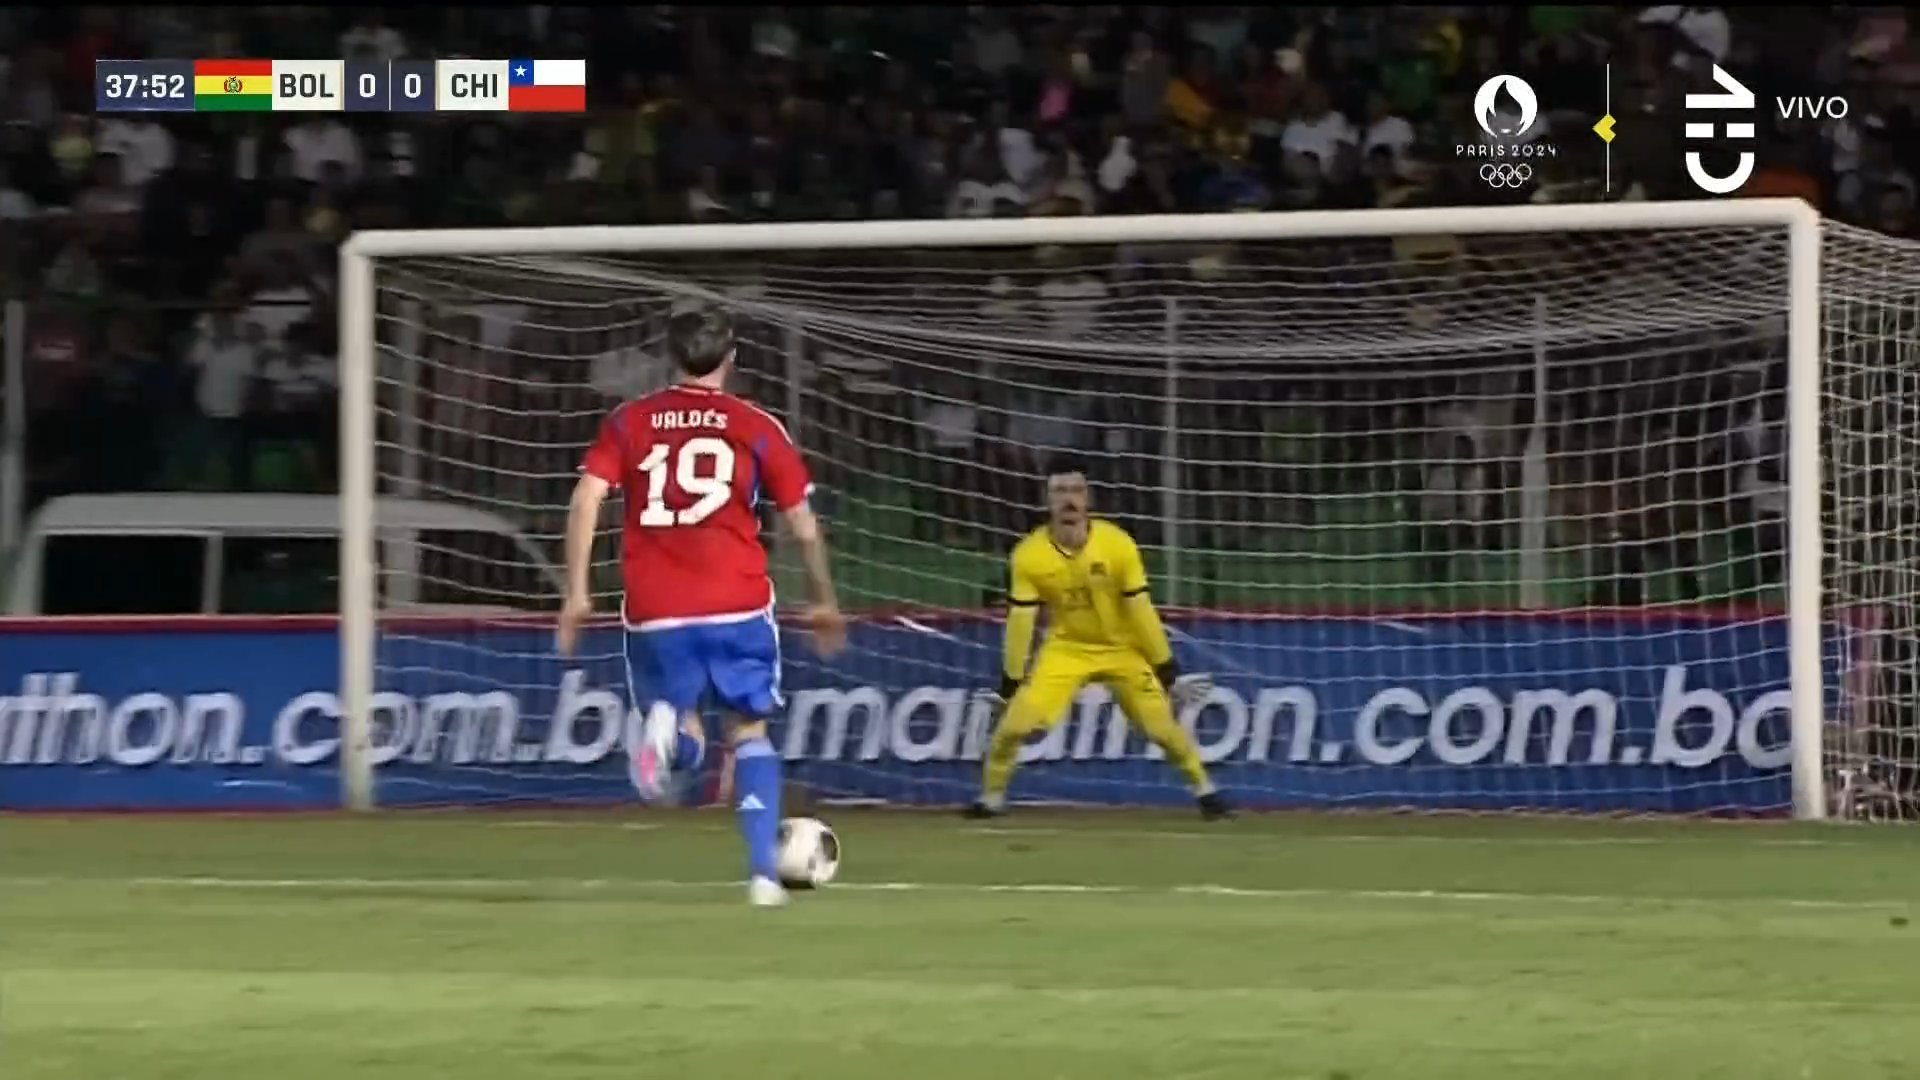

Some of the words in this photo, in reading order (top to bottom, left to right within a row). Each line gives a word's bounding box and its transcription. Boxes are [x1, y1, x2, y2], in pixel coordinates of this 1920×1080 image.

[651, 408, 728, 430] VALDÉS
[638, 437, 735, 526] 19
[0, 668, 641, 764] thon.com.b
